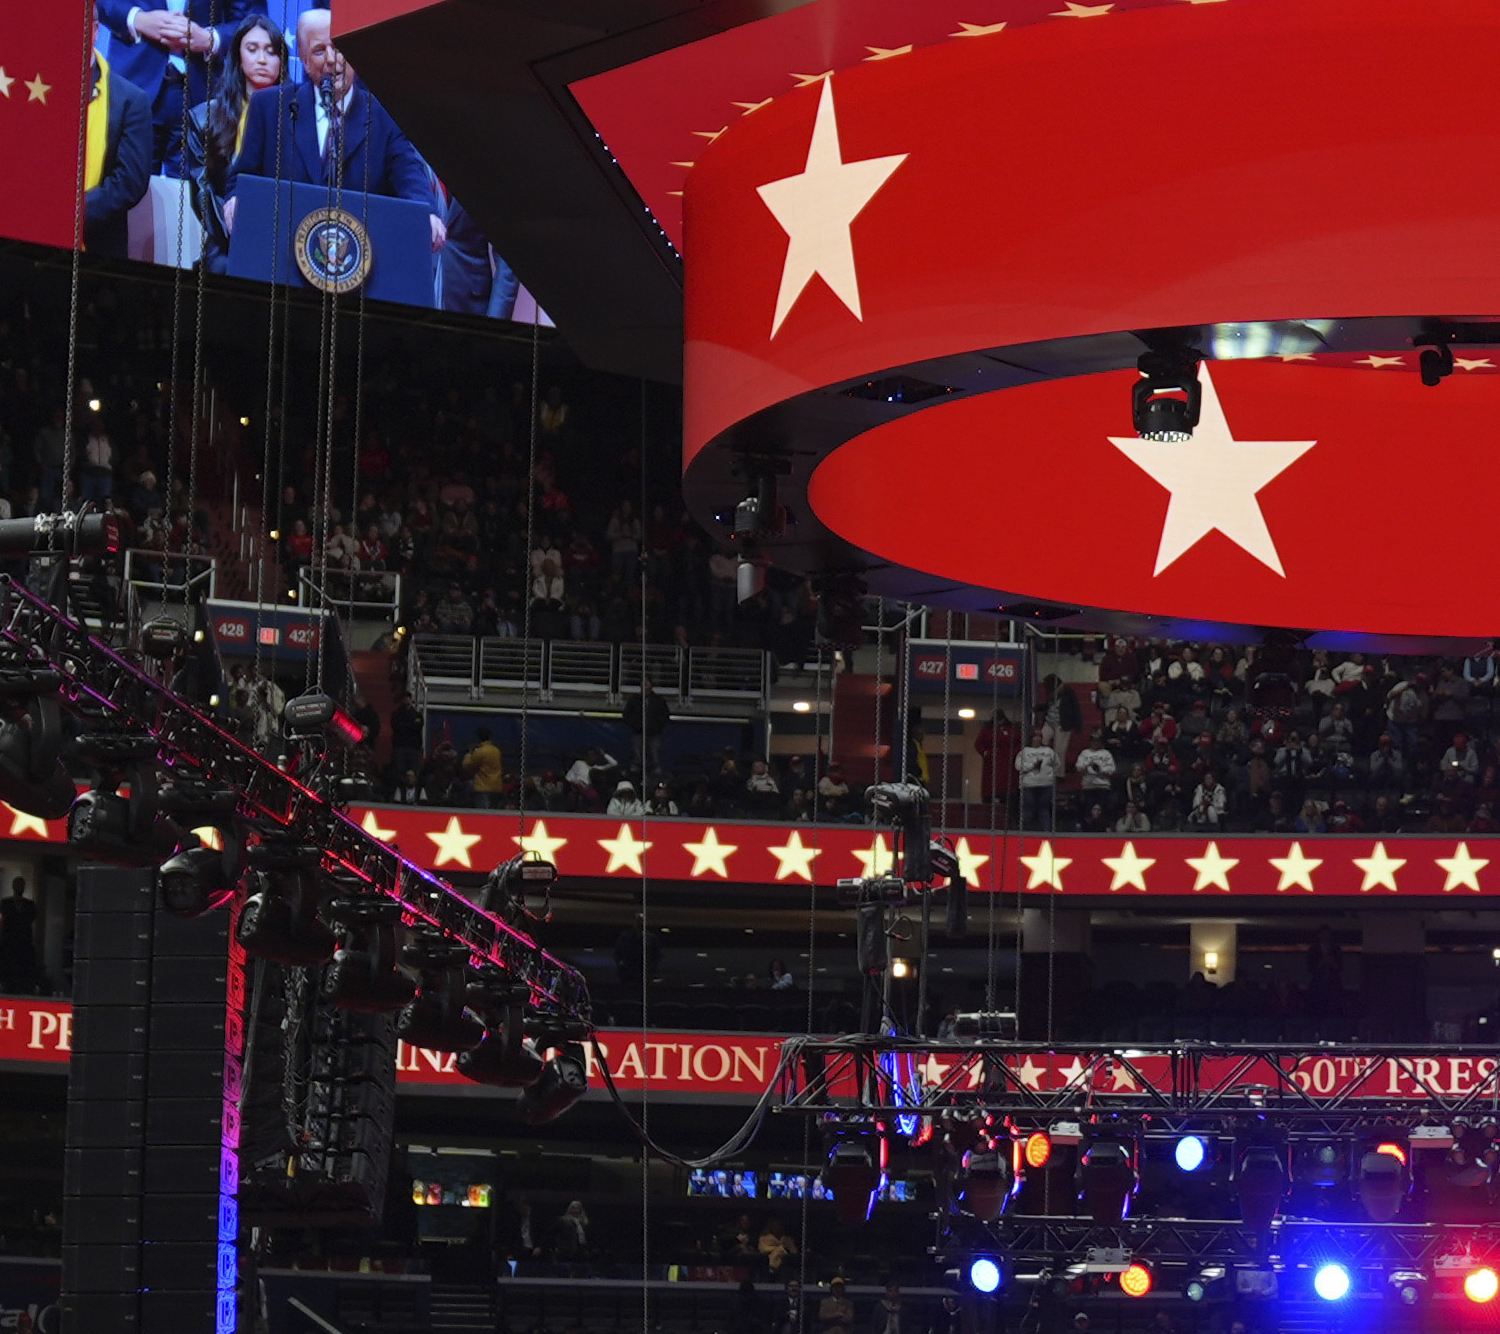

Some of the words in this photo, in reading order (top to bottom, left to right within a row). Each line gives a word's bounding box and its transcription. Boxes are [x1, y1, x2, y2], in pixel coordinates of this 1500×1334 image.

[218, 622, 245, 637] 428
[918, 660, 944, 675] 427
[988, 663, 1014, 678] 426
